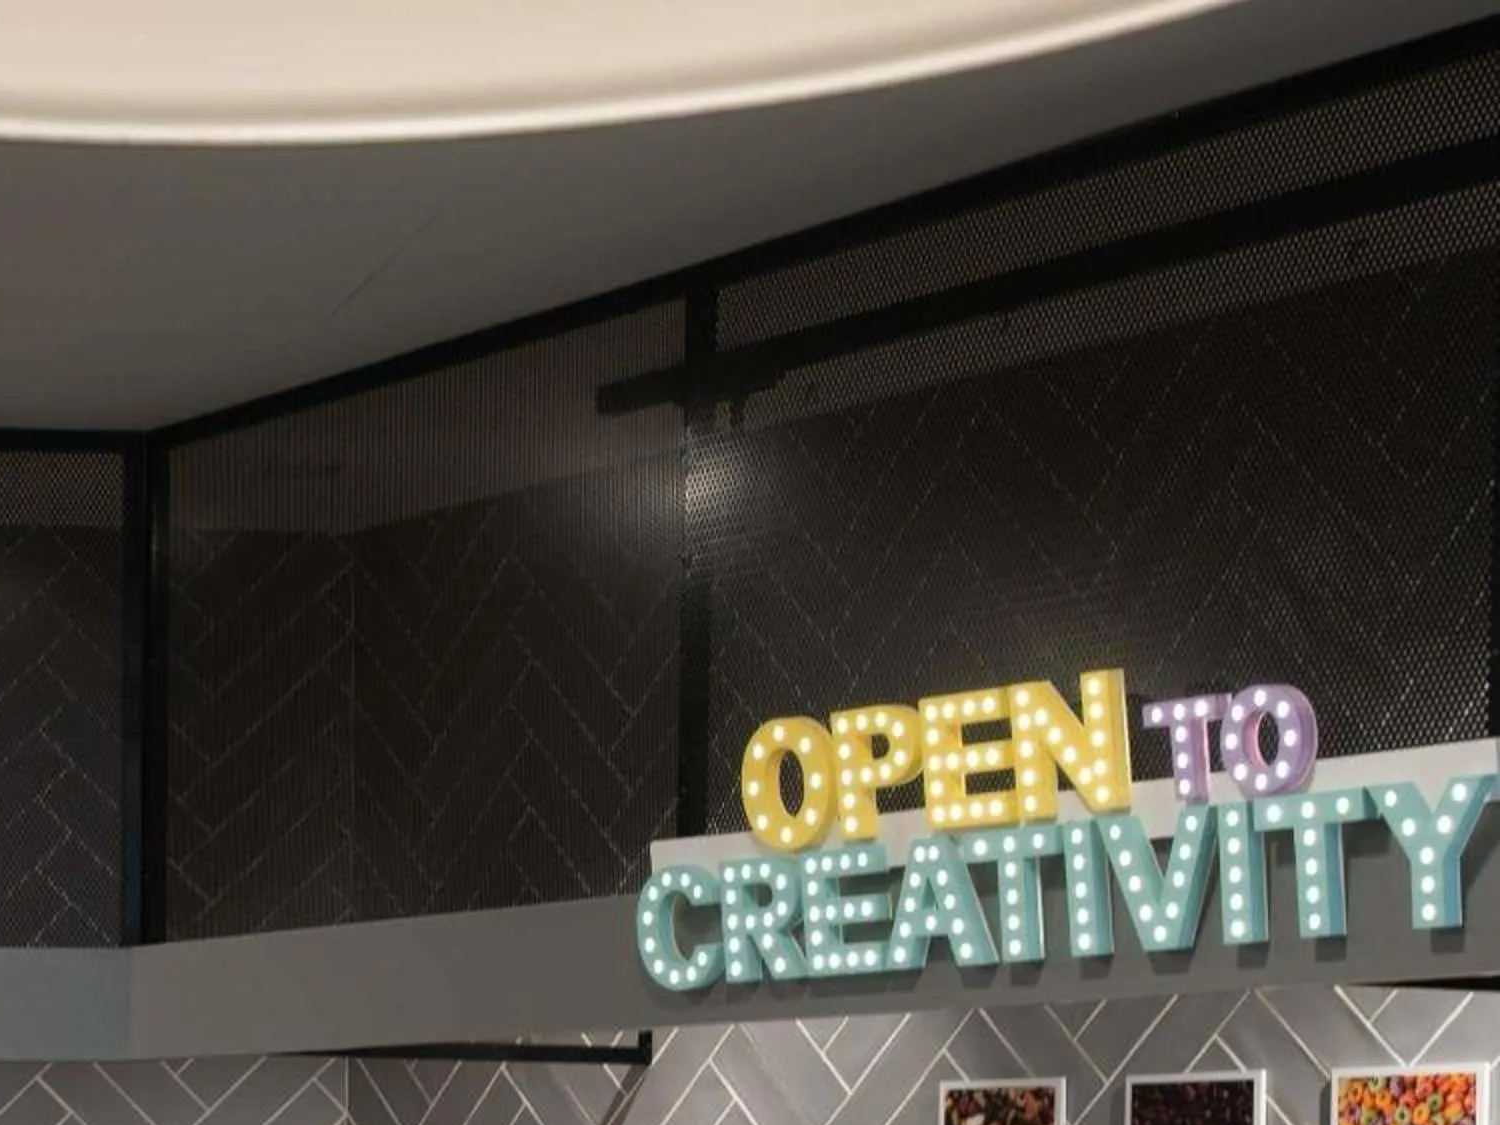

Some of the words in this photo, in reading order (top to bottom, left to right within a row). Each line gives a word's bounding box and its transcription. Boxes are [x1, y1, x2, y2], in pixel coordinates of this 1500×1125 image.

[741, 667, 1132, 852] OPEN
[1142, 683, 1319, 802] TO
[636, 773, 1499, 991] CREATIVITY
